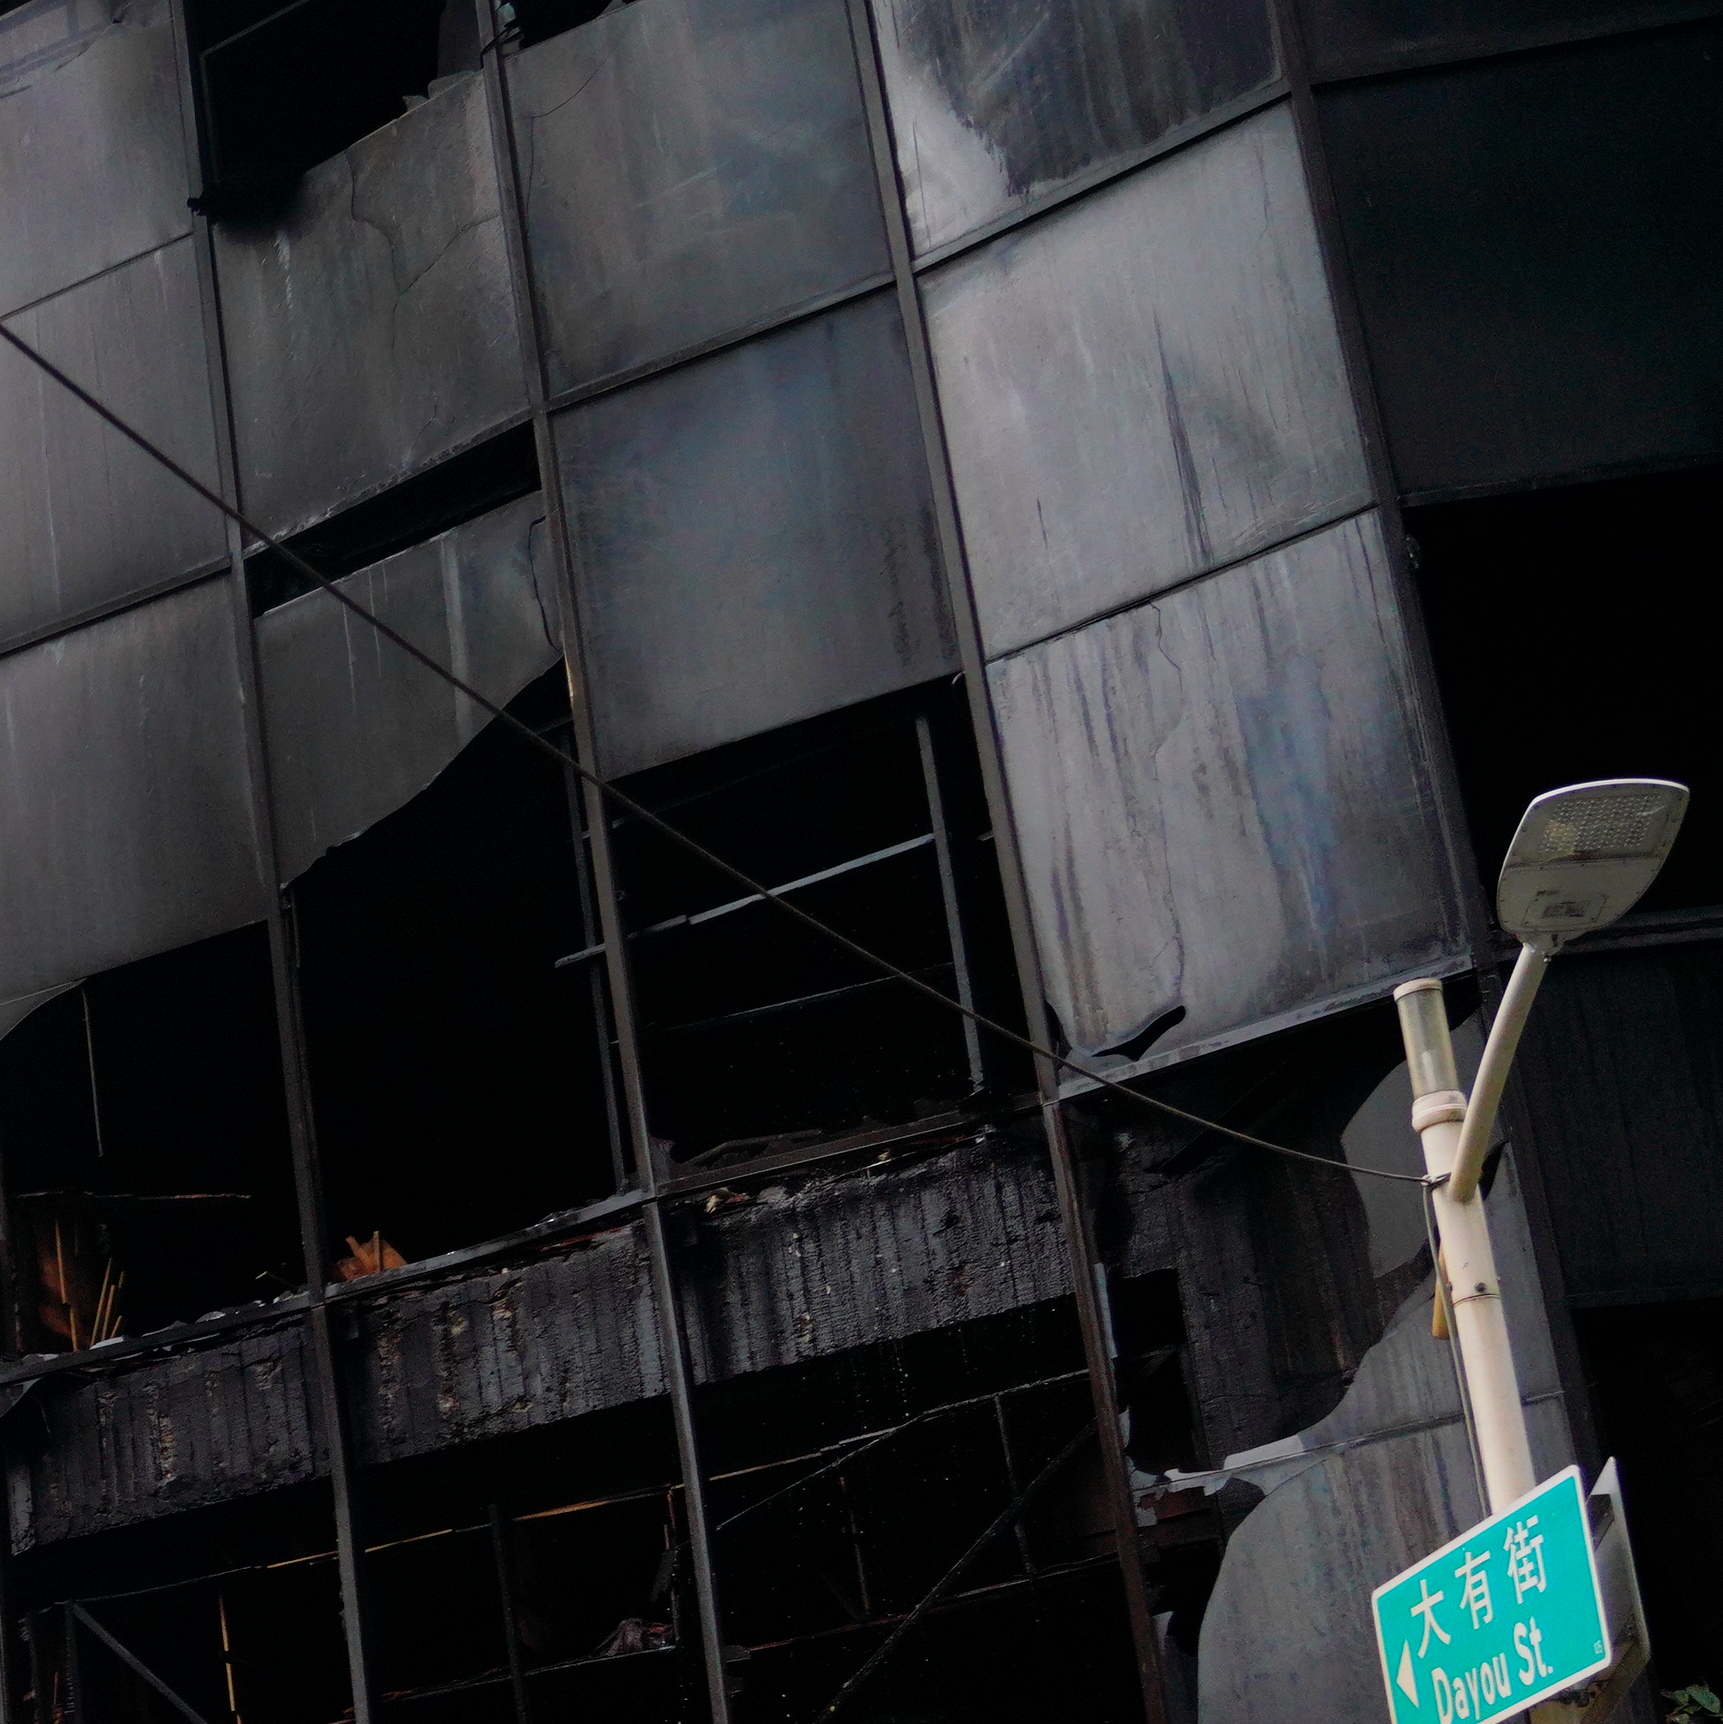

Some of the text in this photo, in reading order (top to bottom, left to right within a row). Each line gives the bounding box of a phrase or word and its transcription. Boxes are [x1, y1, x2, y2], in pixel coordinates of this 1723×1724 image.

[1410, 1515, 1548, 1658] 大有街
[1513, 1616, 1554, 1686] St.
